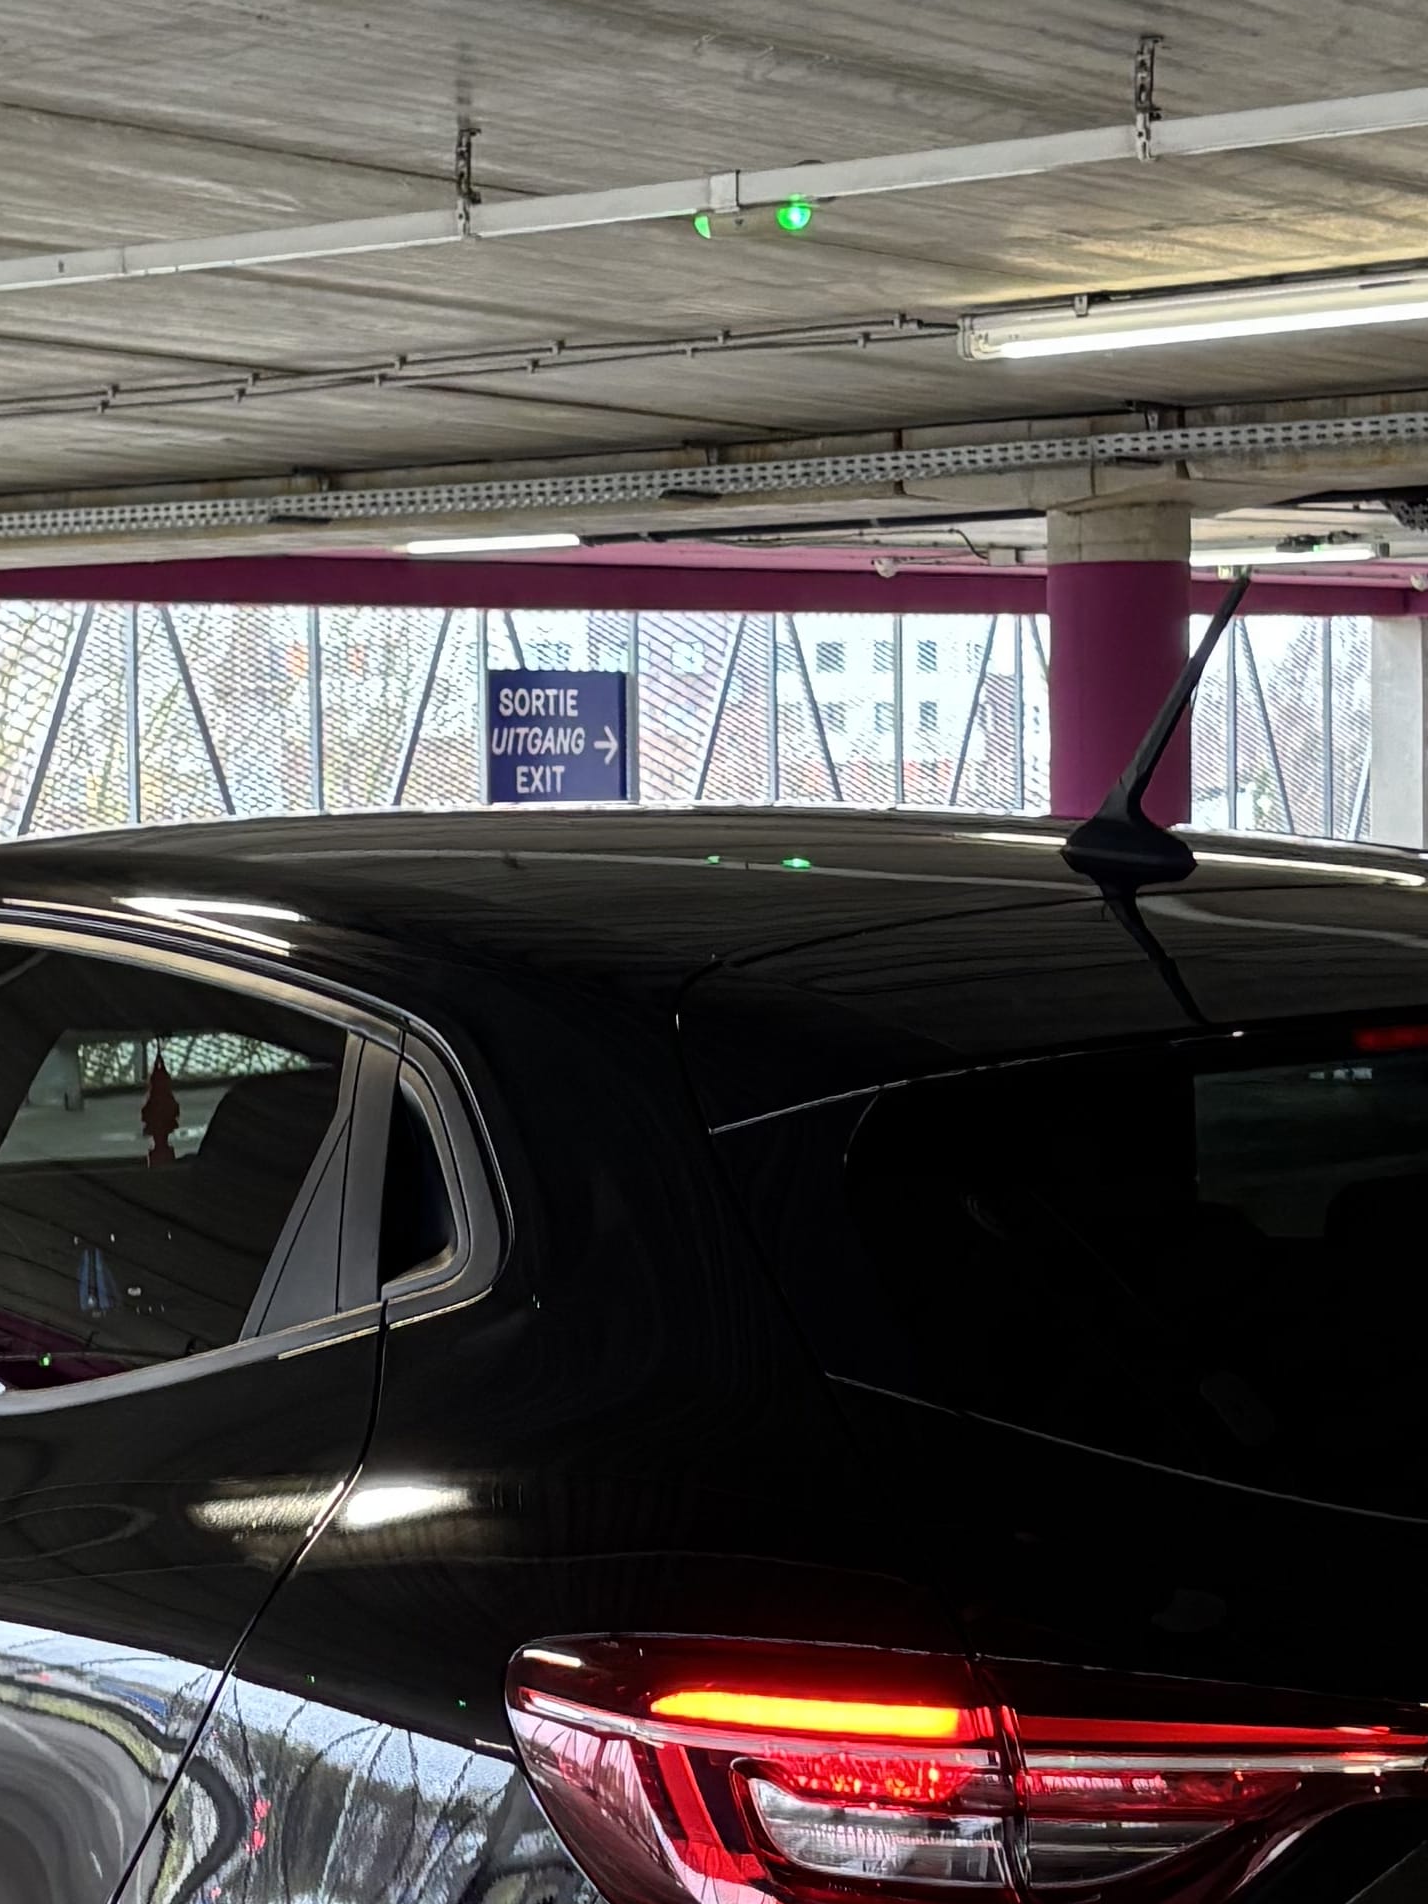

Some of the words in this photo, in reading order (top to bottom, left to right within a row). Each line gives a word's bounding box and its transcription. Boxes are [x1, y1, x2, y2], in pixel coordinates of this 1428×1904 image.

[498, 688, 580, 717] SORTIE
[491, 726, 586, 756] UITGANG
[515, 765, 566, 795] EXIT
